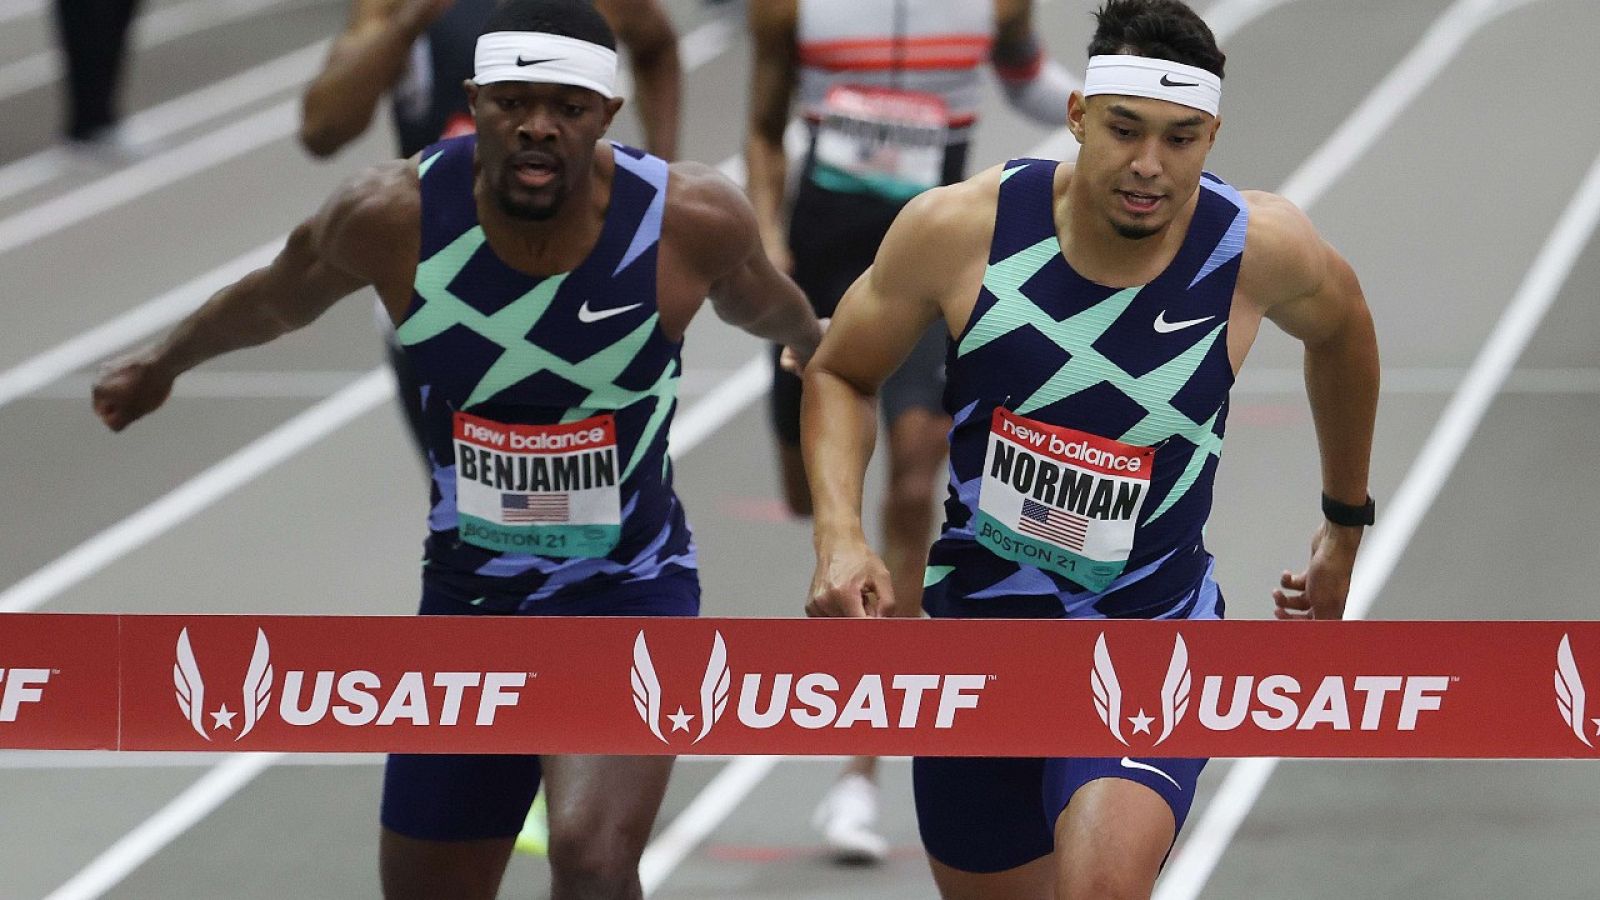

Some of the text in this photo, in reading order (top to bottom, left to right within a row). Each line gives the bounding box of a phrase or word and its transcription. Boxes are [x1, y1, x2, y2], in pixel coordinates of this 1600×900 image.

[464, 422, 605, 449] new balance
[1003, 418, 1142, 472] new balance
[459, 444, 615, 492] BENJAMIN
[990, 440, 1142, 521] NORMAN
[464, 523, 540, 546] BOSTON
[546, 534, 567, 548] 21
[980, 521, 1052, 562] BOSTON
[1057, 555, 1077, 572] 21
[0, 668, 50, 721] F
[280, 670, 526, 726] USATF
[737, 673, 986, 729] USATF
[1199, 675, 1449, 730] USATF
